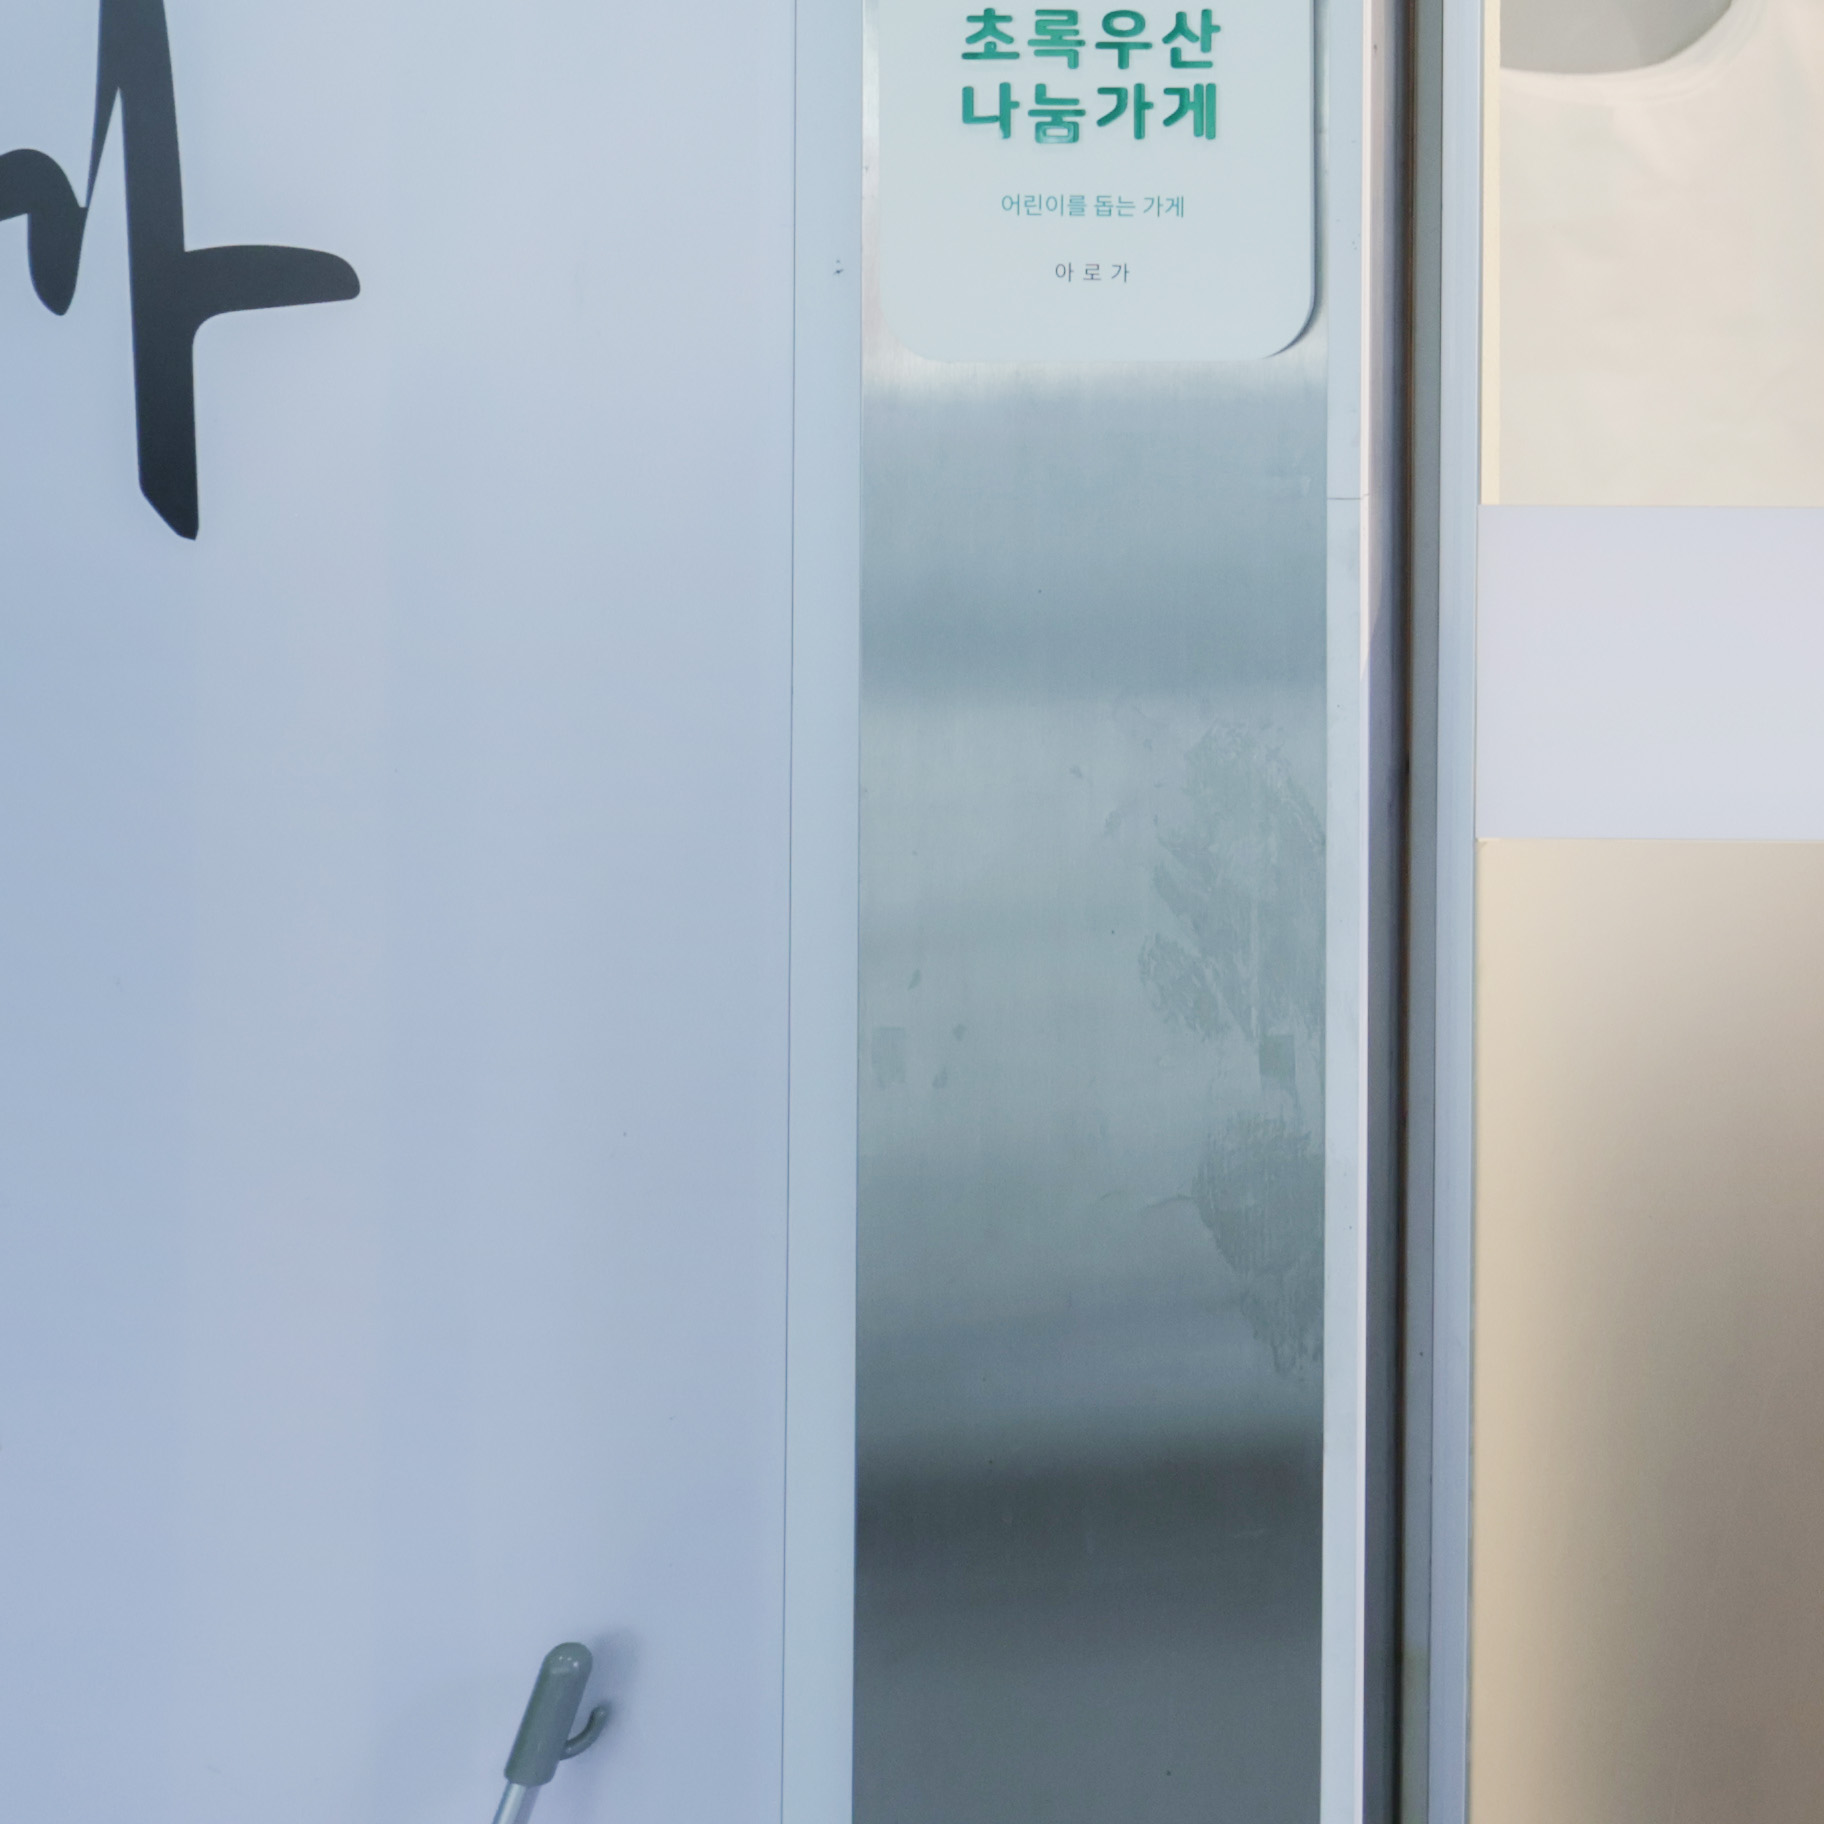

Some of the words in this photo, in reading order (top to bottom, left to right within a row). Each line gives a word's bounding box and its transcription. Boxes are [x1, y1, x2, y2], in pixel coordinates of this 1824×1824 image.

[961, 8, 1221, 69] 초록우산
[961, 83, 1217, 144] 나눔가게
[1001, 194, 1087, 218] 어린이를
[1094, 195, 1136, 218] 돕는
[1143, 195, 1186, 219] 가게
